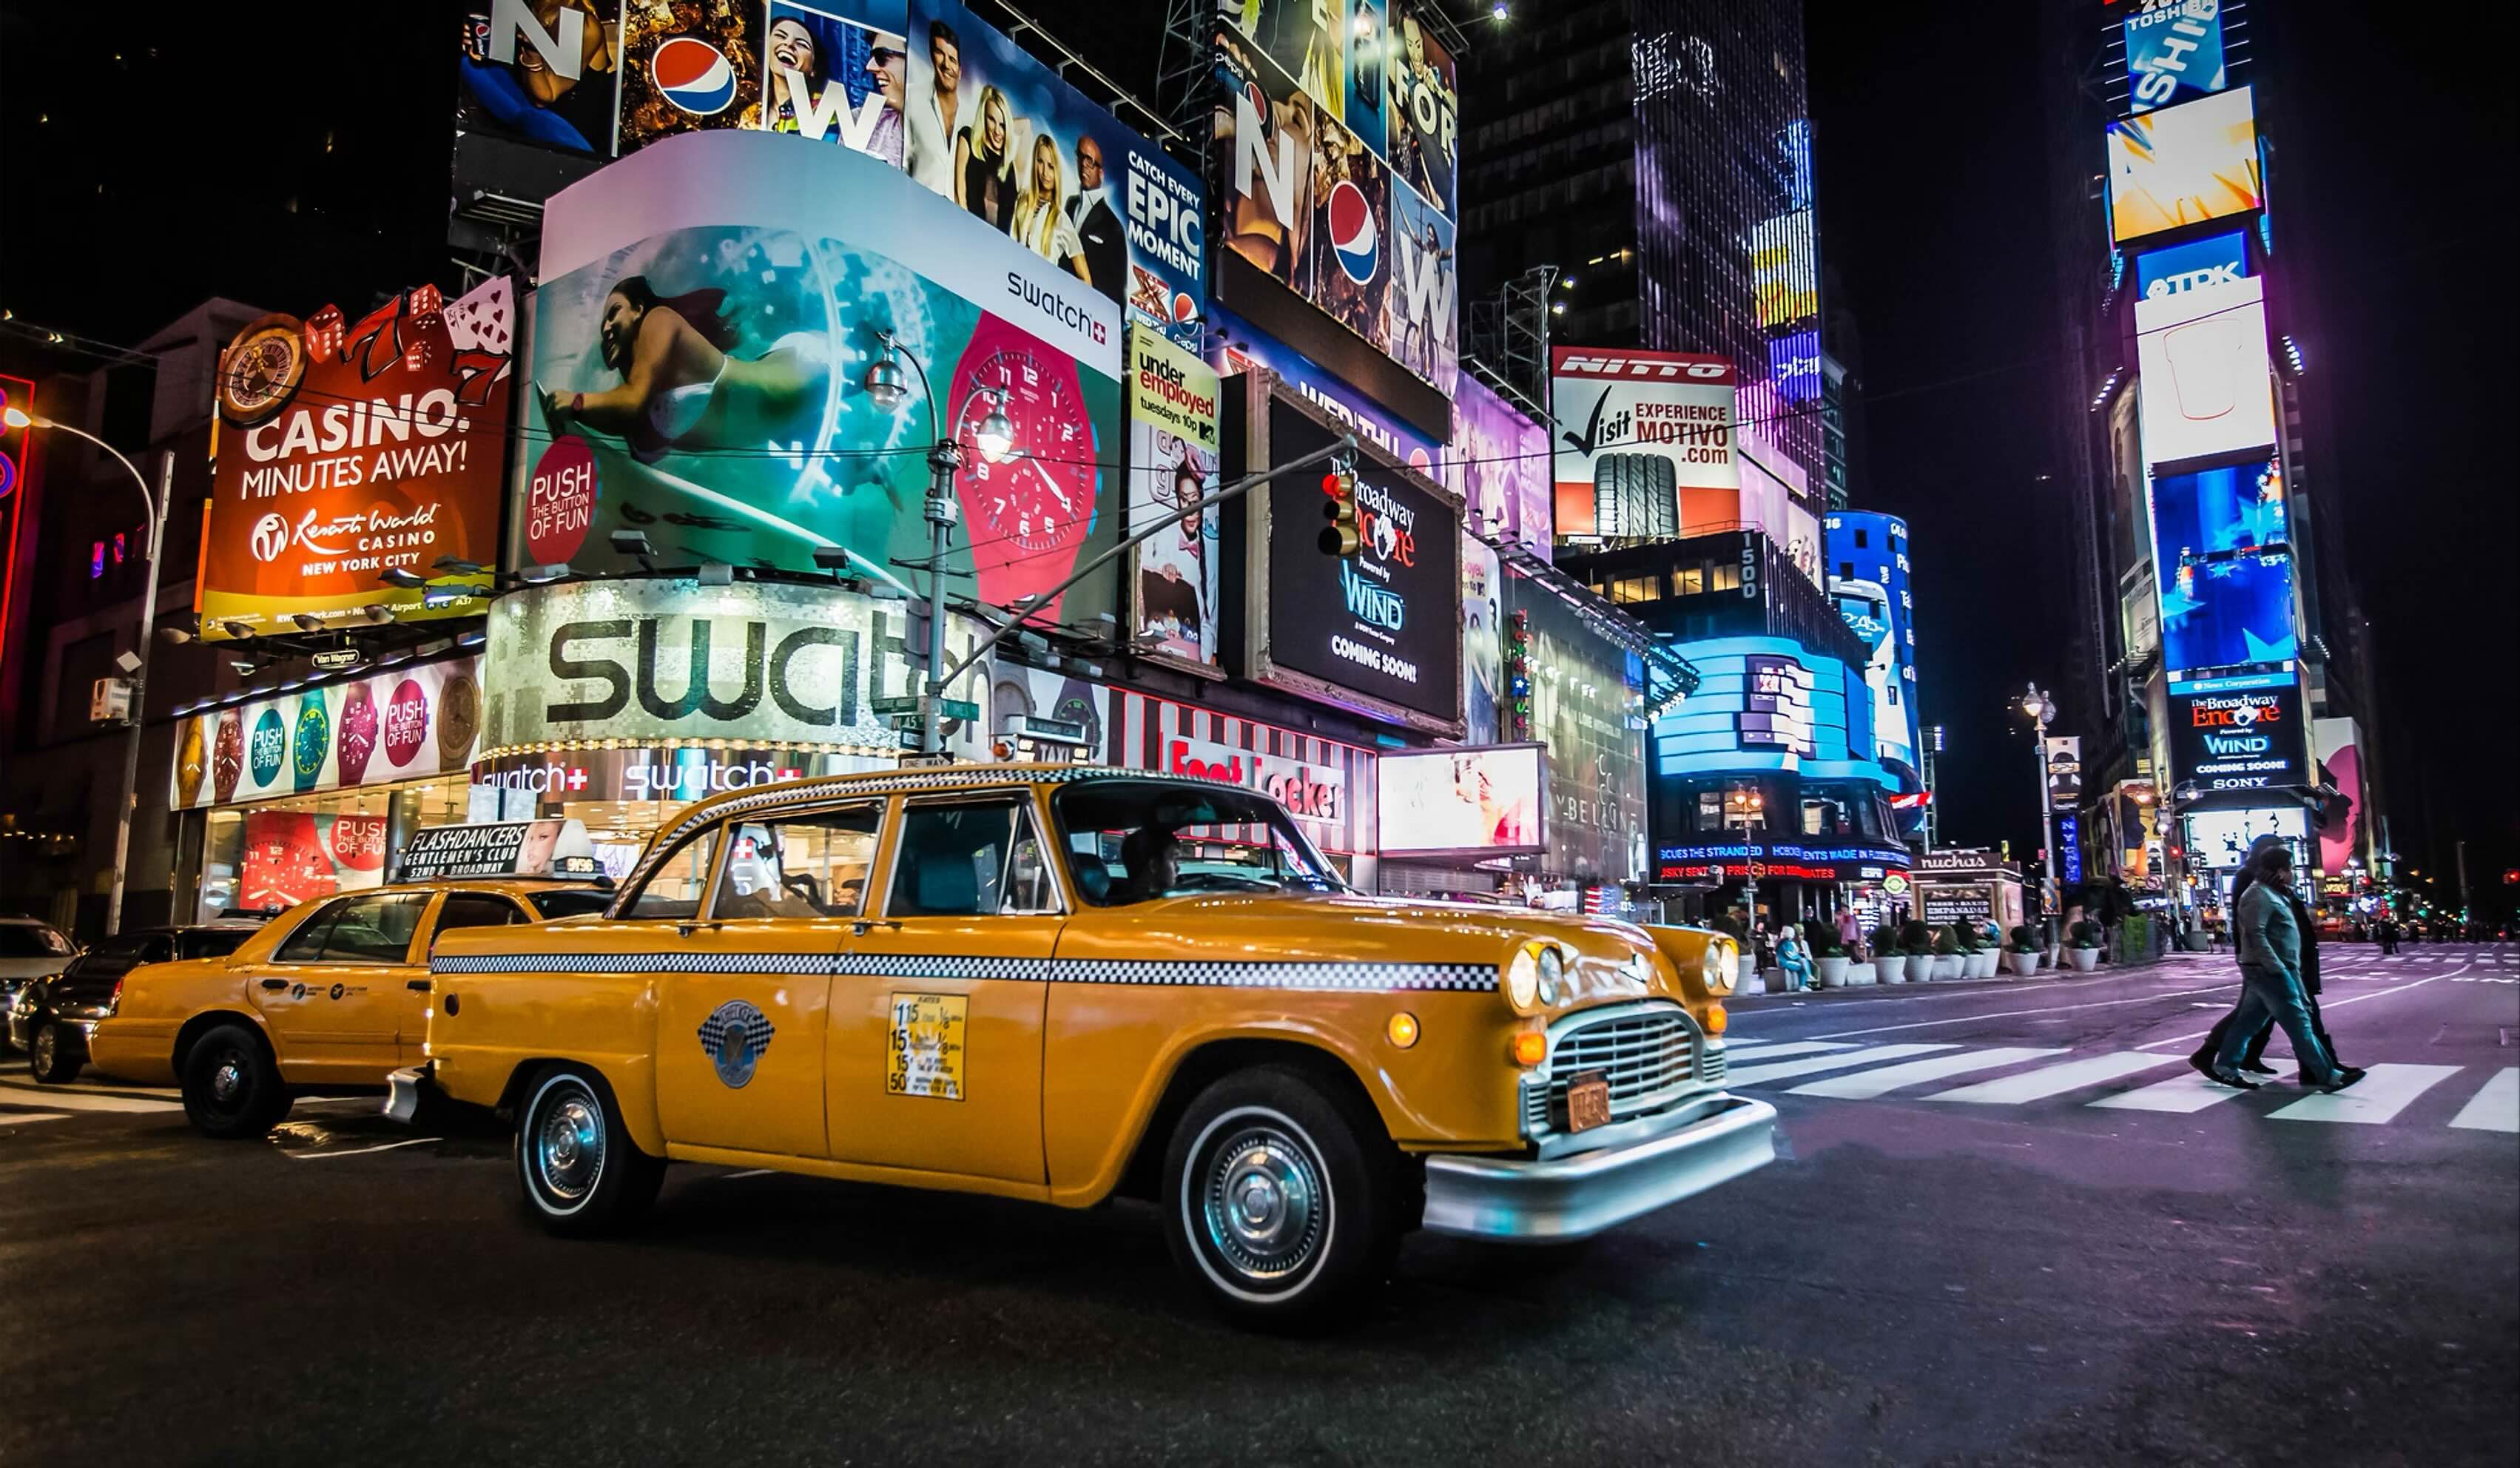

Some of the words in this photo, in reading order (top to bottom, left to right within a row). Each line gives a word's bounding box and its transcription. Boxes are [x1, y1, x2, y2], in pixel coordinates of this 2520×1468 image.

[1395, 58, 1458, 161] FOR
[1128, 150, 1165, 186] CATCH
[1168, 176, 1200, 209] EVERY
[1128, 169, 1200, 257] EPIC
[1128, 219, 1200, 280] MOMENT
[2169, 260, 2243, 294] TDK
[1007, 272, 1093, 340] swatch
[1139, 352, 1185, 387] under
[1560, 356, 1730, 378] NITTO
[1140, 371, 1214, 419] employed
[246, 388, 470, 462] CASINO.
[1140, 396, 1181, 424] tuesdays
[1182, 414, 1197, 432] 10p
[1635, 403, 1727, 422] EXPERIENCE
[1637, 421, 1728, 447] MOTIVO
[1681, 448, 1728, 465] .com
[241, 454, 363, 500] MINUTES
[371, 440, 468, 482] AWAY!
[532, 462, 591, 505] PUSH
[532, 505, 549, 518] THE
[551, 492, 590, 513] BUTTON
[530, 518, 551, 540] OF
[556, 506, 588, 533] FUN
[358, 530, 436, 552] CASINO
[303, 562, 335, 576] NEW
[341, 556, 380, 573] YORK
[385, 551, 421, 568] CITY
[1359, 556, 1381, 576] Powered
[1381, 567, 1390, 583] by
[1742, 532, 1756, 599] 1500
[1342, 559, 1404, 630] WIND
[391, 602, 422, 613] Airport
[317, 656, 329, 664] Van
[330, 653, 356, 664] Wagner
[1331, 636, 1381, 671] COMING
[1382, 653, 1418, 684] SOON!
[388, 699, 424, 724] PUSH
[2207, 695, 2278, 710] Broadway
[388, 724, 400, 733] THE
[400, 720, 422, 730] BUTTON
[892, 718, 900, 730] W
[904, 716, 917, 728] 45
[254, 727, 283, 748] PUSH
[387, 733, 401, 747] OF
[402, 730, 422, 744] FUN
[2204, 734, 2268, 755] WIND
[253, 756, 264, 769] OF
[265, 753, 281, 767] FUN
[905, 760, 918, 768] ONE
[926, 759, 945, 767] WAY
[1040, 744, 1070, 764] TAXI
[482, 761, 566, 792] swatch
[625, 761, 775, 791] swatch
[2196, 764, 2246, 773] COMING
[2247, 761, 2285, 770] SOON!
[1253, 756, 1345, 818] Locker
[2213, 777, 2268, 789] SONY
[336, 843, 357, 853] OF
[363, 843, 385, 855] FU
[410, 826, 528, 852] FLASHDANCERS
[405, 849, 482, 866] GENTLEMEN'S
[487, 847, 517, 861] CLUB
[1690, 848, 1705, 858] THE
[1707, 846, 1762, 858] STRANDED
[1921, 854, 1987, 869] nuchas
[411, 866, 434, 878] 52ND
[450, 862, 504, 876] BROADWAY
